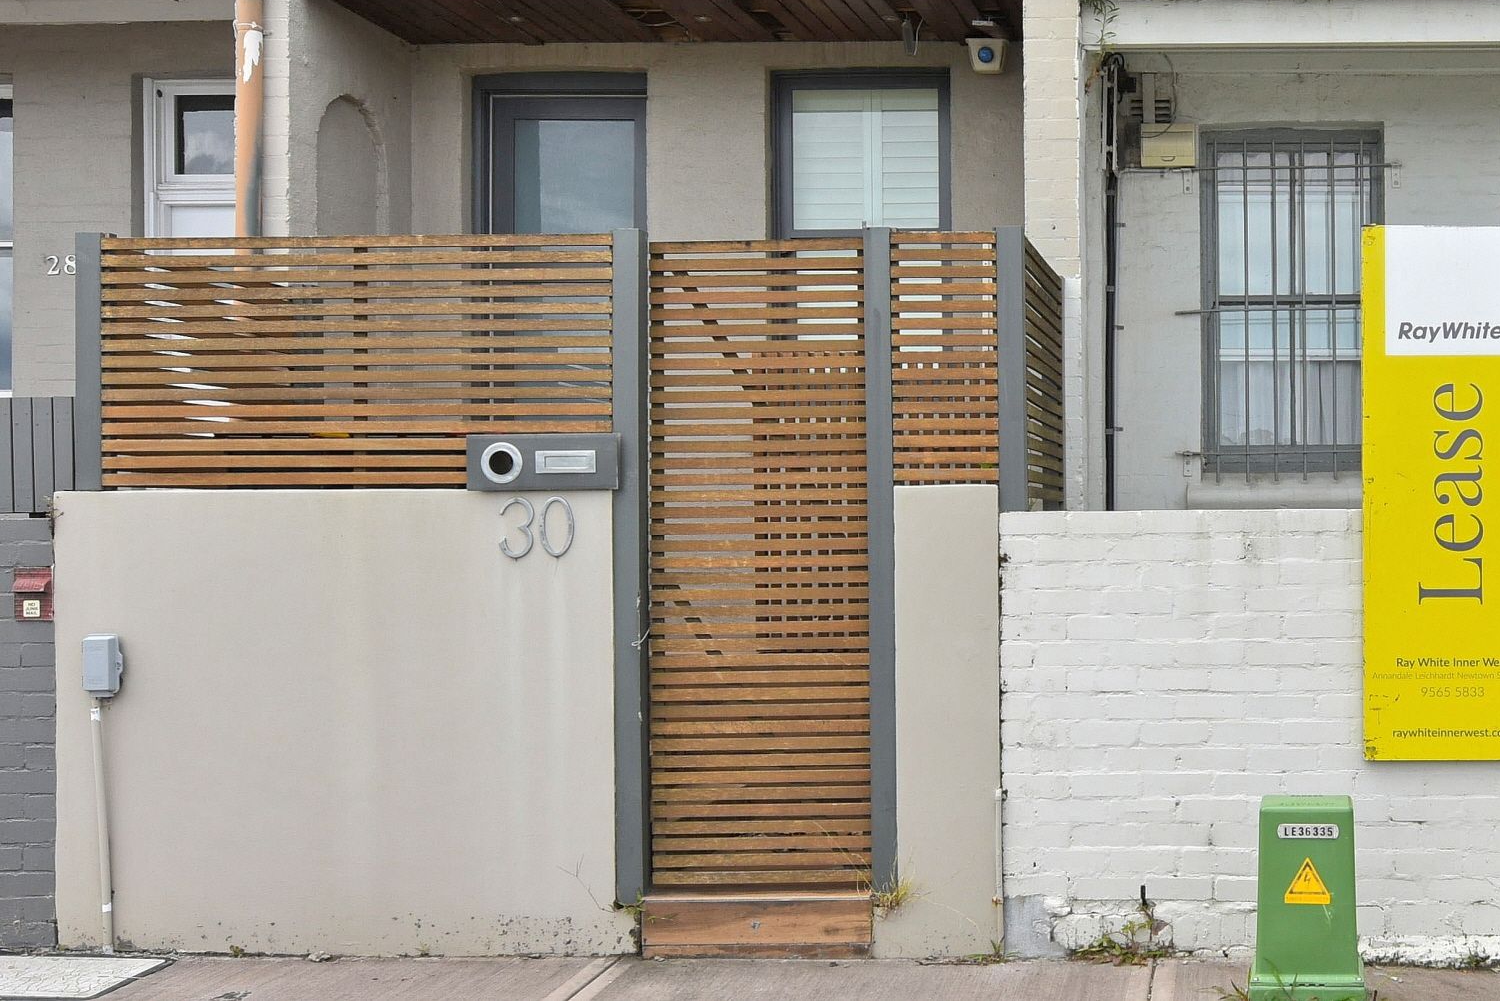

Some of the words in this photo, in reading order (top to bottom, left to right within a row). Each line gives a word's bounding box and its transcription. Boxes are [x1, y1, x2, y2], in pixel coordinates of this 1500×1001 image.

[46, 254, 76, 276] 28
[1418, 382, 1484, 605] Lease
[498, 496, 575, 559] 30
[1396, 657, 1416, 669] Ray
[1417, 657, 1450, 667] White
[1453, 657, 1480, 667] Inner
[1372, 671, 1412, 680] Annandale
[1415, 671, 1454, 680] Leichhardt
[1457, 671, 1494, 680] Newtown
[1420, 686, 1451, 698] 9565
[1455, 686, 1485, 698] 5833
